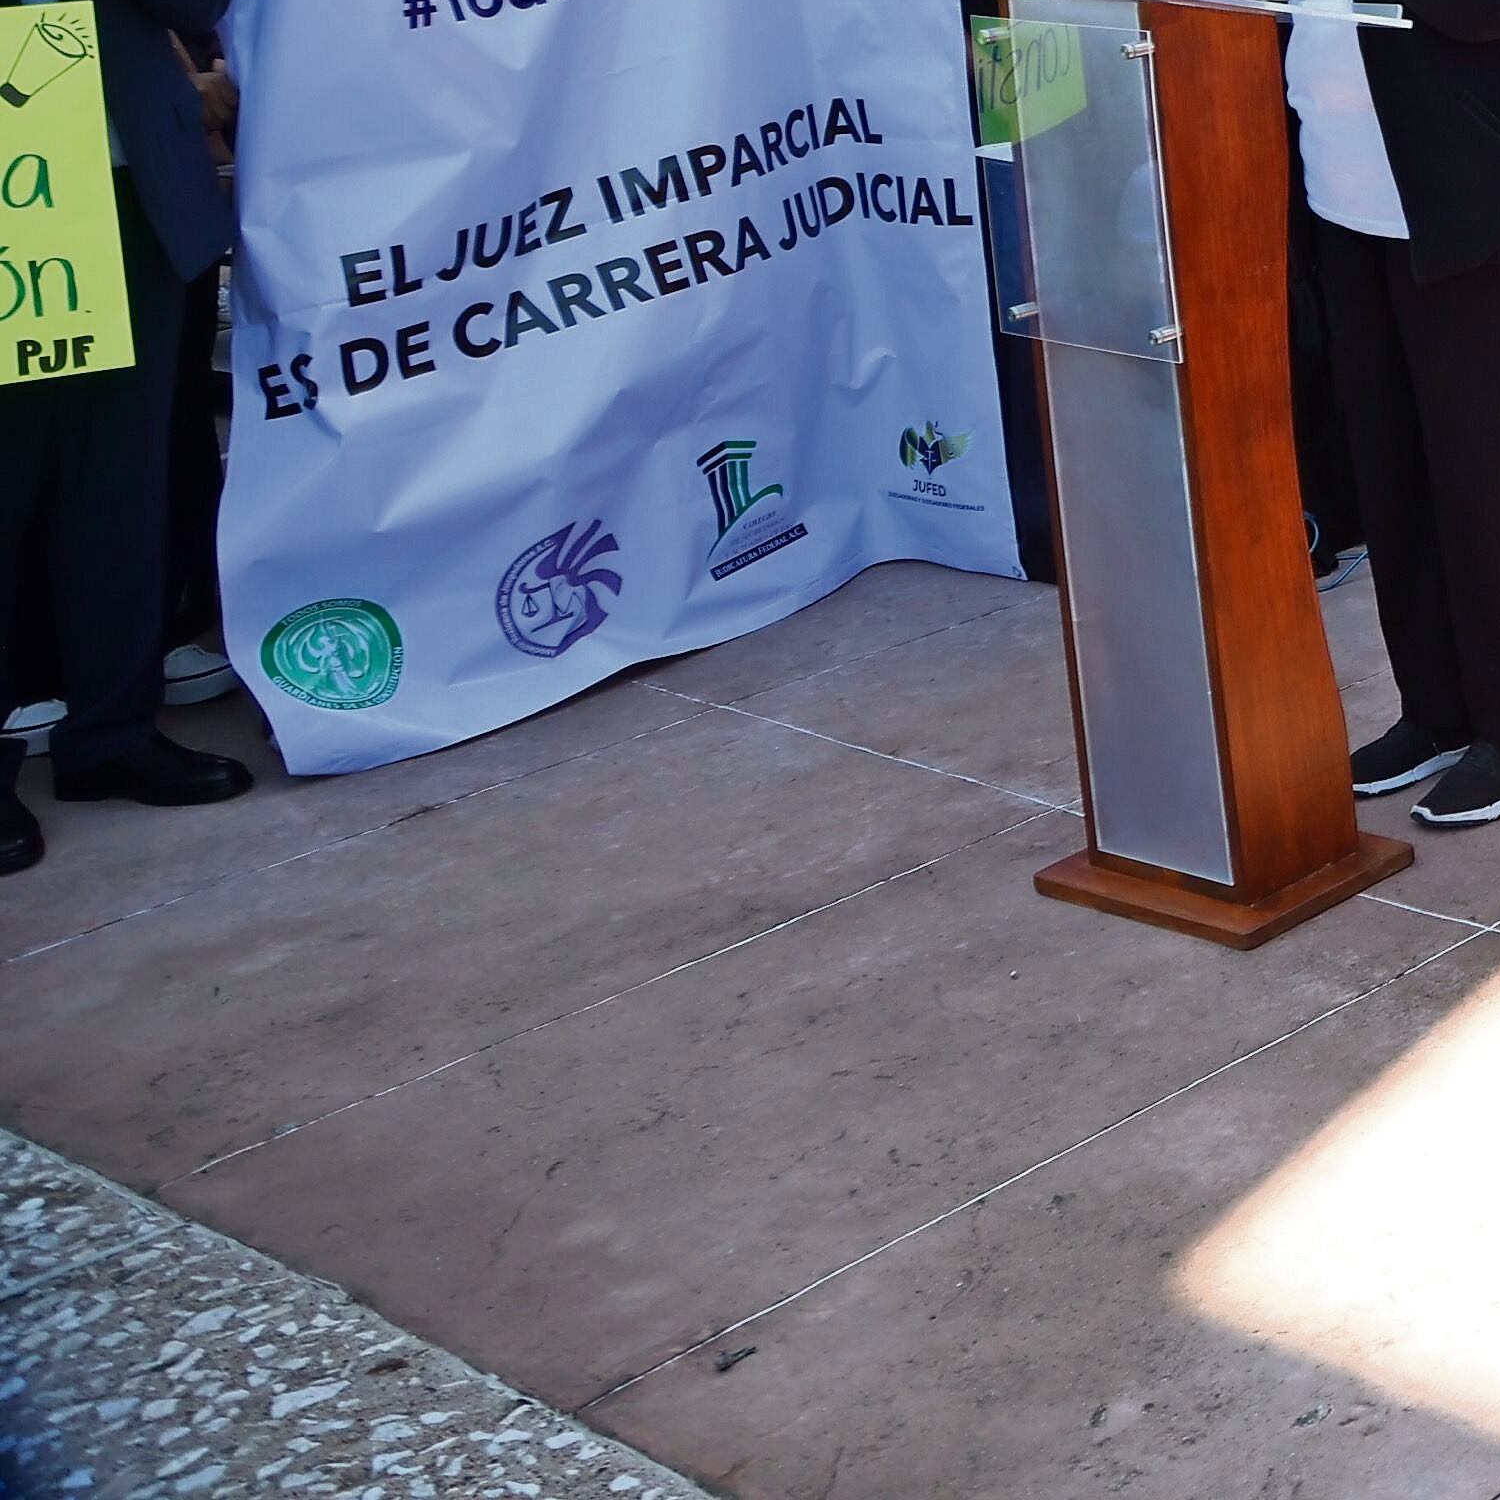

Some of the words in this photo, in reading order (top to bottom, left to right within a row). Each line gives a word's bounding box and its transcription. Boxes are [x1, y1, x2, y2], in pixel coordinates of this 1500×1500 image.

[341, 245, 422, 307] EL
[436, 186, 587, 283] JUEZ
[597, 97, 883, 225] IMPARCIAL
[16, 335, 95, 376] PJF
[257, 353, 319, 421] ES
[338, 321, 436, 397] DE
[452, 227, 772, 359] CARRERA
[778, 171, 974, 252] JUDICIAL
[912, 479, 947, 497] JUFED
